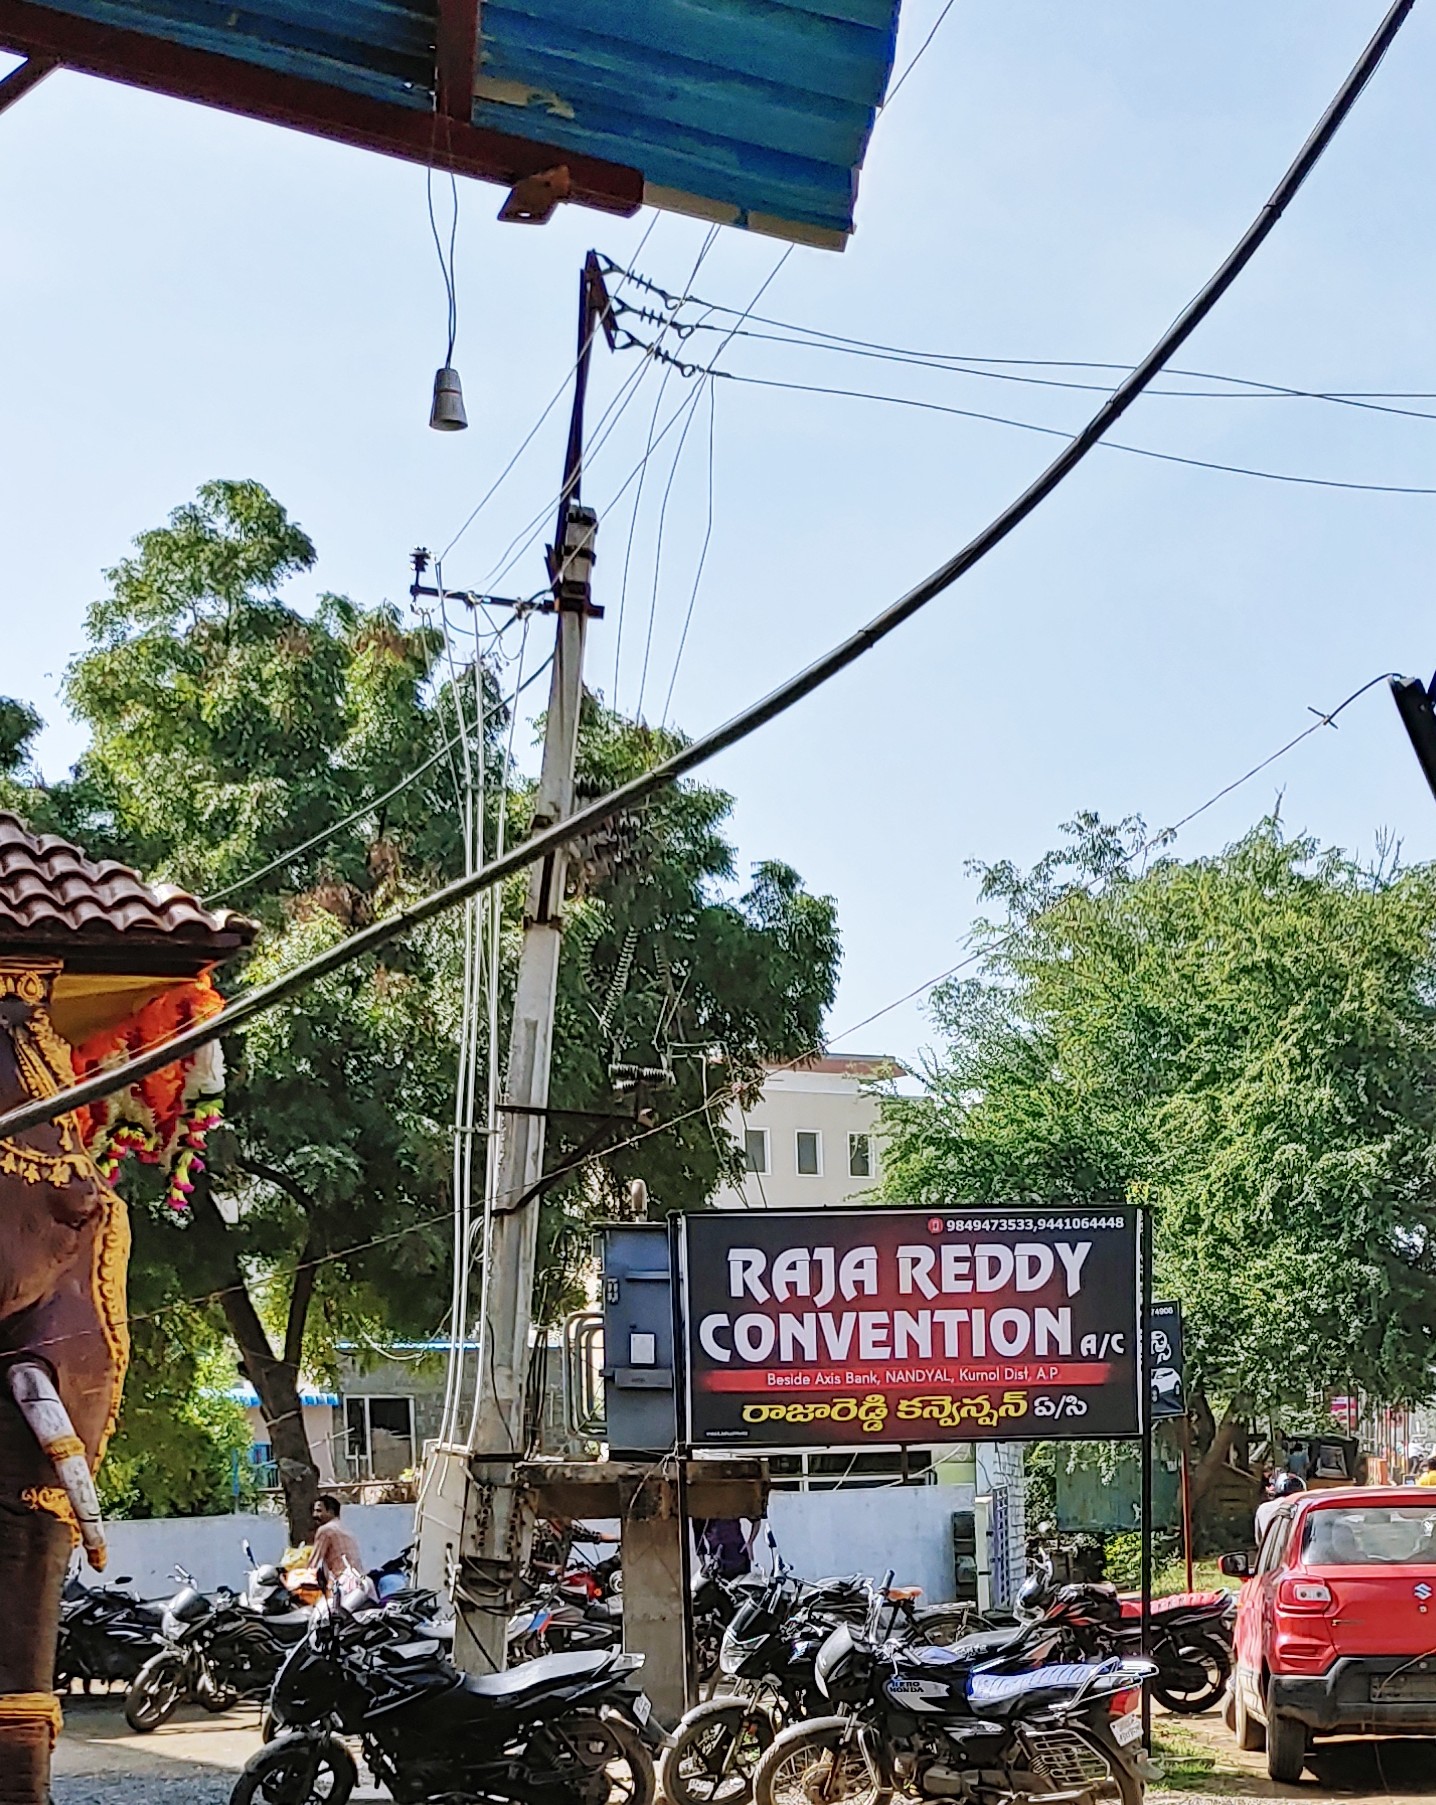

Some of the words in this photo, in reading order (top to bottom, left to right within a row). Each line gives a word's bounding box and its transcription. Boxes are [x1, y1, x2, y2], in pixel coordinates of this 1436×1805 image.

[727, 1246, 878, 1308] RAJA
[896, 1241, 1093, 1301] REDDY
[699, 1307, 1072, 1363] CONVENTION
[1080, 1333, 1125, 1359] A/C
[767, 1372, 811, 1386] Beside
[814, 1372, 842, 1385] Axis
[845, 1370, 881, 1385] Bank,
[885, 1367, 955, 1384] NANDYAL,
[742, 1393, 889, 1432] రాజారెడ్డి
